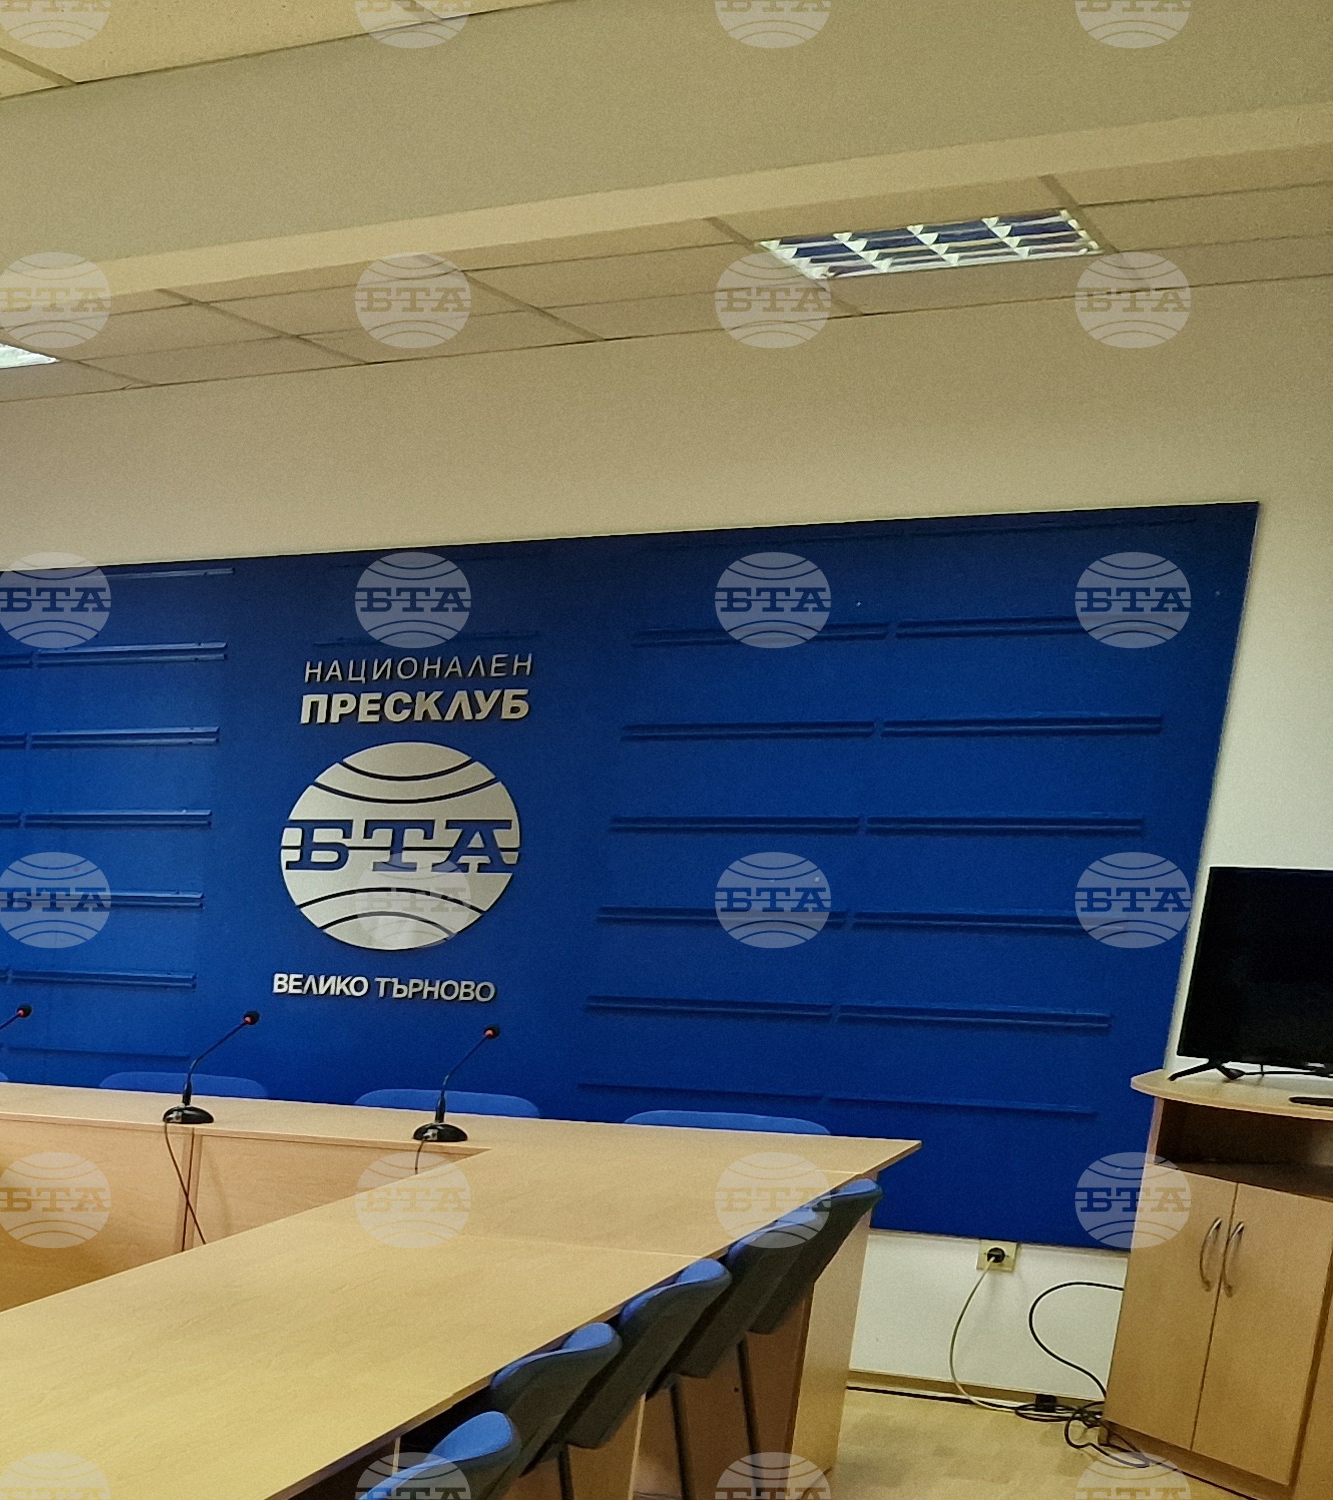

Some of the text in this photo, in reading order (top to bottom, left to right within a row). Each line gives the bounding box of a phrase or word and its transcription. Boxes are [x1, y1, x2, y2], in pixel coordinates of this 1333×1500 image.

[304, 653, 533, 684] НАЦИОНАЛЕН
[300, 688, 530, 724] ПРЕСКЛУБ
[286, 819, 515, 873] БТА
[272, 973, 496, 1002] ВЕЛИКО ТЪРНОВО
